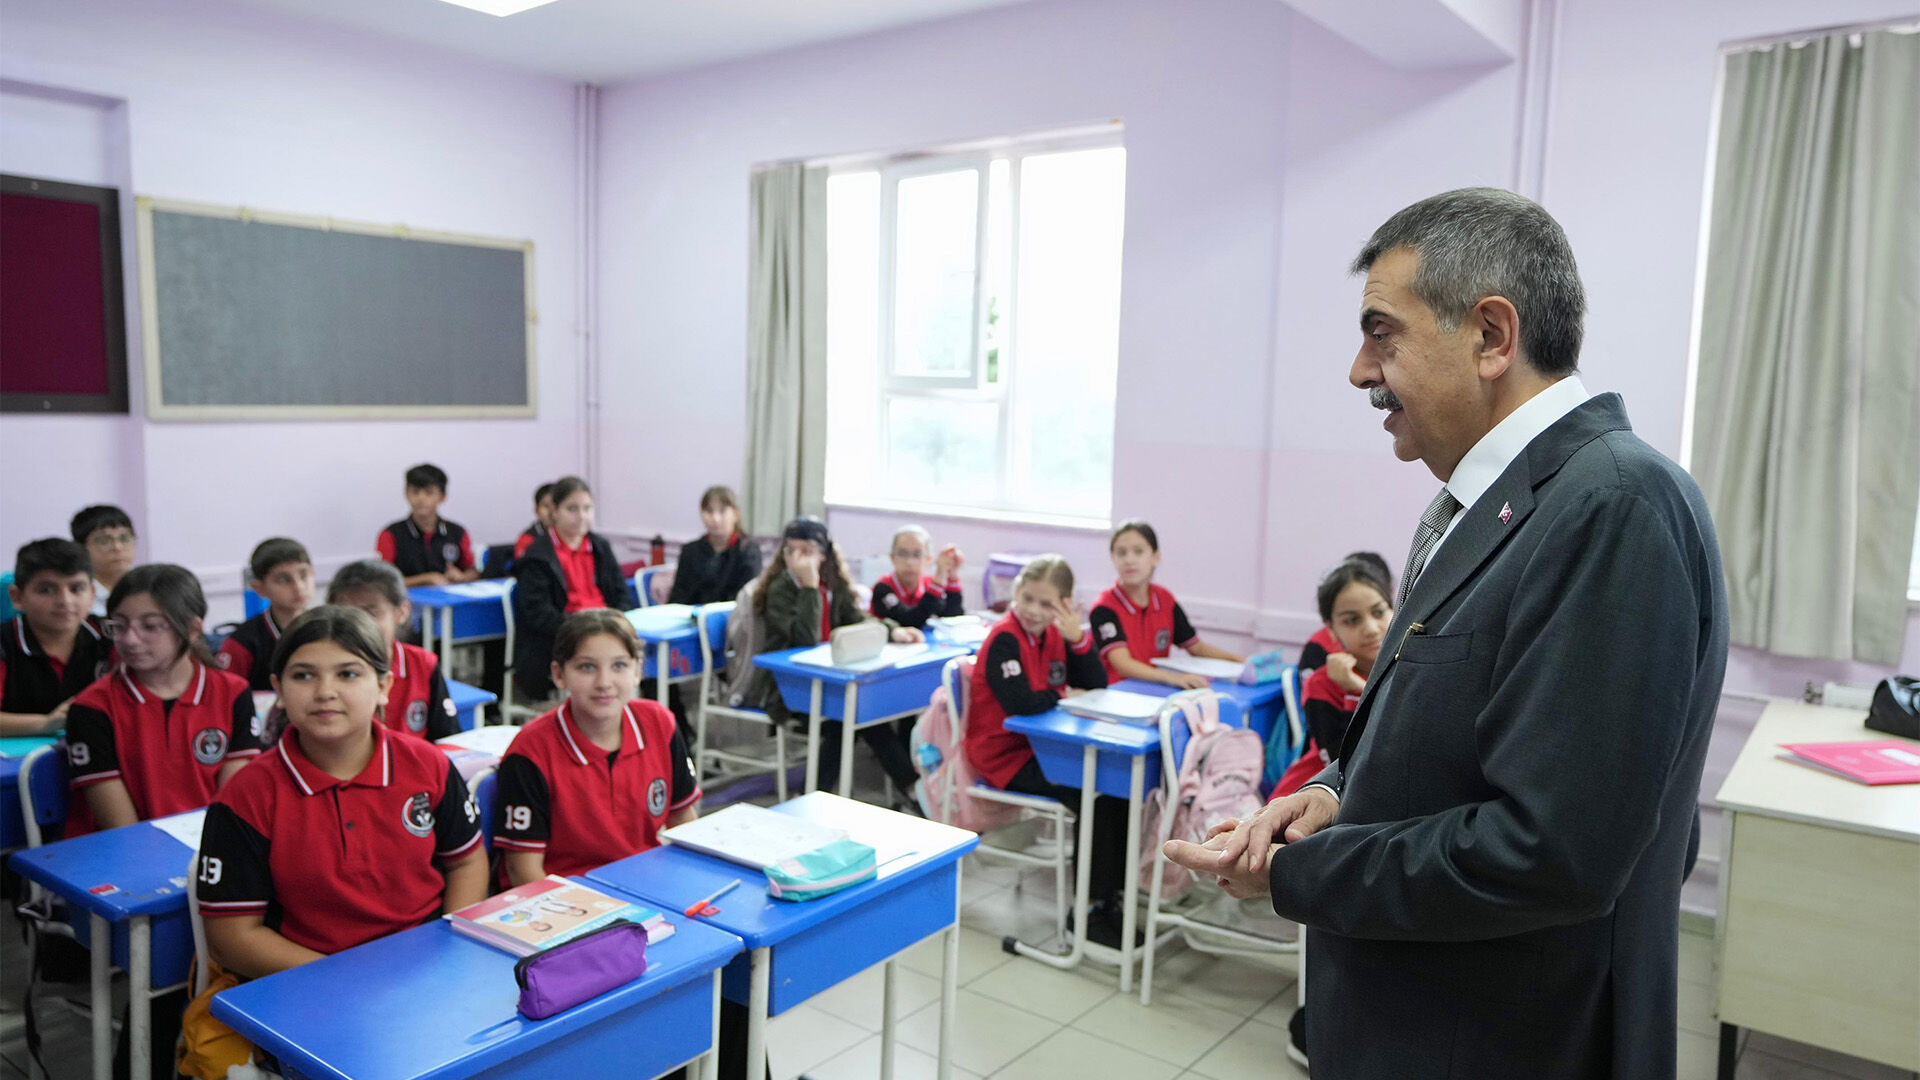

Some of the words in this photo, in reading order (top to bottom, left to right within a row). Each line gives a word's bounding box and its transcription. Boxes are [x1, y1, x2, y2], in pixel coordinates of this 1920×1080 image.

[1000, 659, 1022, 679] 19
[505, 804, 532, 831] 19
[199, 855, 223, 885] 19
